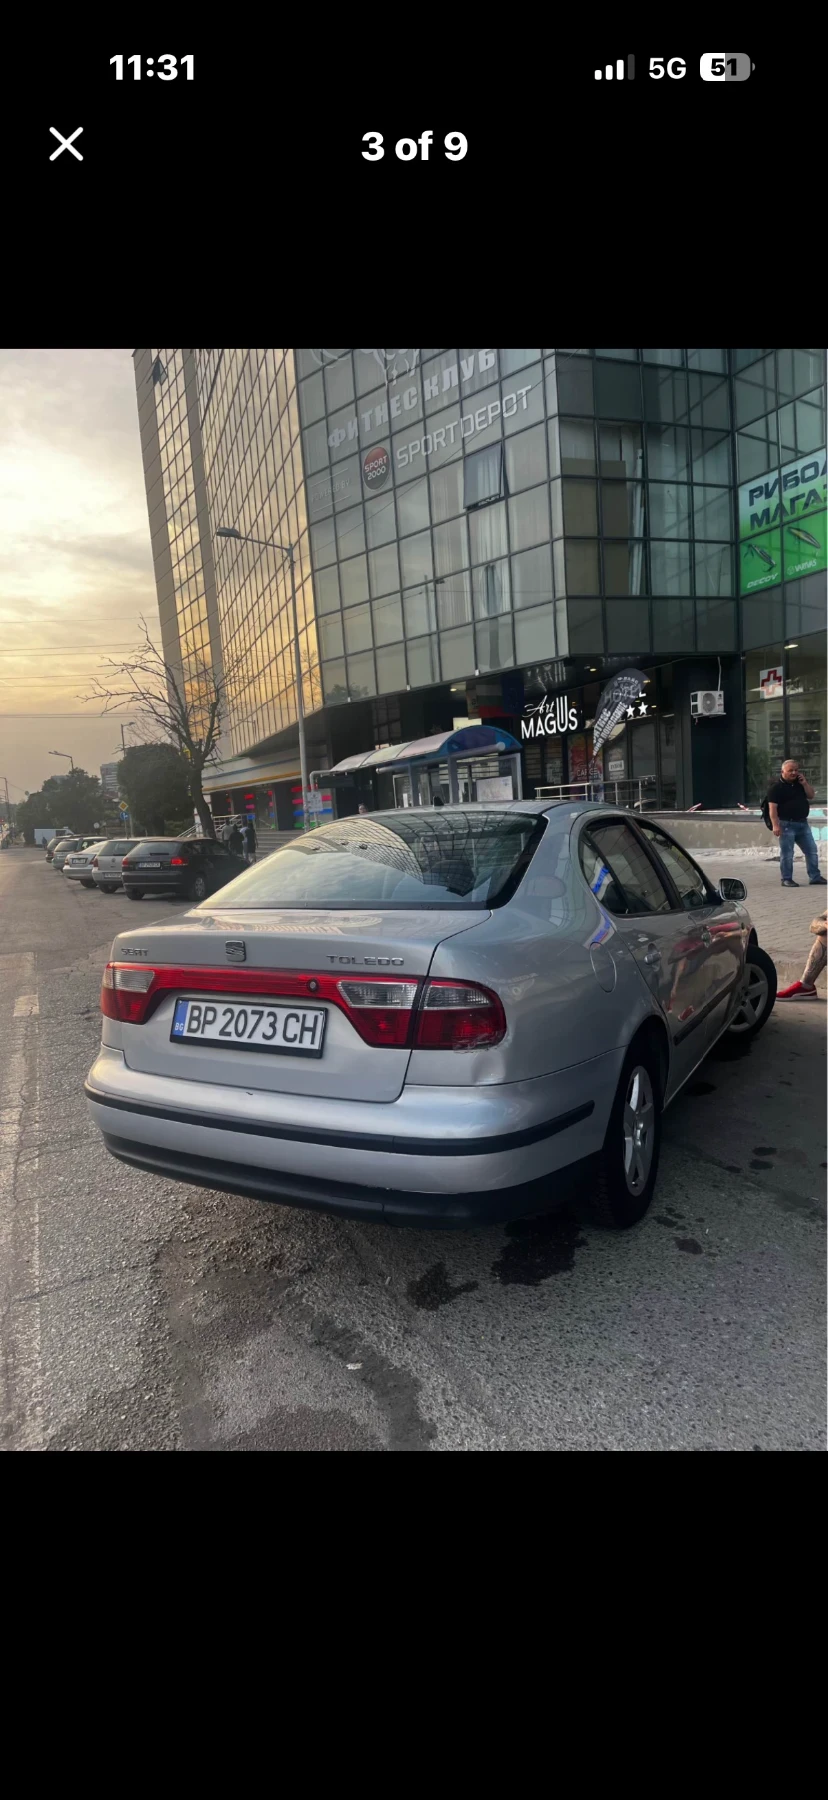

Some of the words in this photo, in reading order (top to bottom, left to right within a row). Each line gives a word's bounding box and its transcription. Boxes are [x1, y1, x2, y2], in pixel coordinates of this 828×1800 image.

[327, 386, 418, 449] ФИТНЕС
[423, 349, 497, 403] КЛУБ
[364, 455, 388, 474] SPORT
[367, 465, 387, 481] 2000
[521, 694, 556, 718] Art
[520, 695, 578, 740] MAGUS
[120, 947, 149, 957] SEAT
[325, 954, 405, 967] TOLEDO
[174, 1022, 184, 1032] BG
[186, 1005, 217, 1035] BP
[218, 1007, 278, 1041] 2073
[282, 1012, 319, 1045] CH
